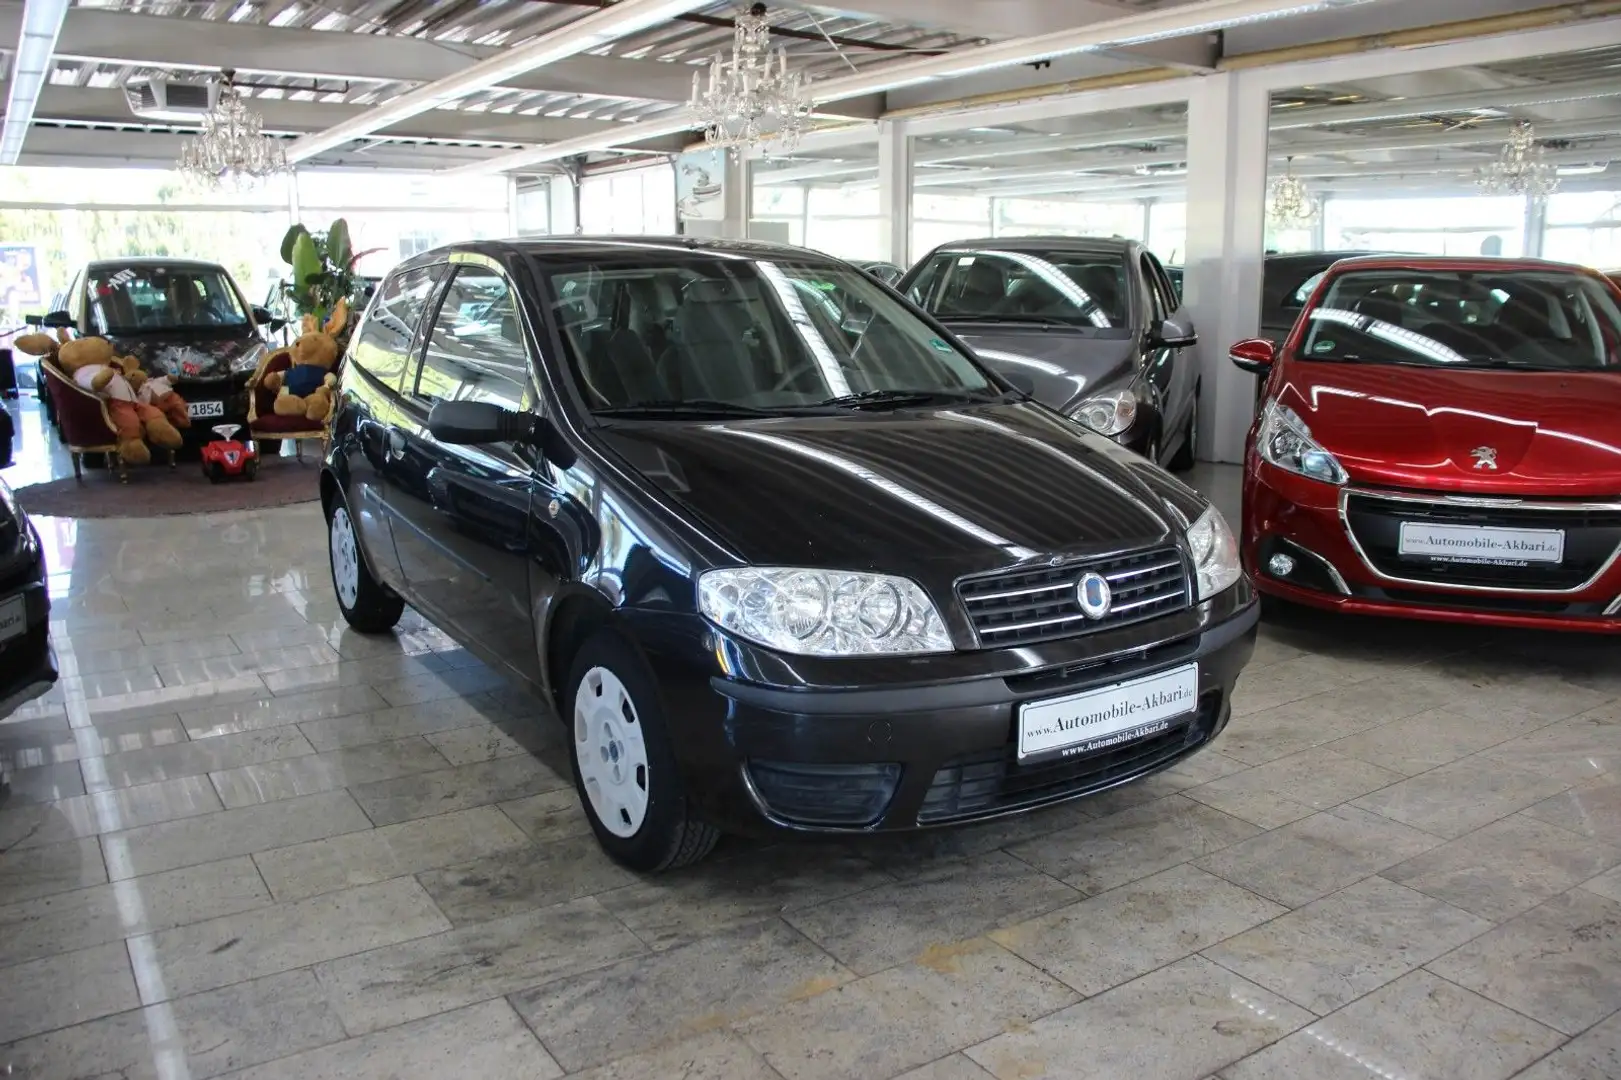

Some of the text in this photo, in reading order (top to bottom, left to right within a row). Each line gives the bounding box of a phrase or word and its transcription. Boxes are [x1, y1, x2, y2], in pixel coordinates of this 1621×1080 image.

[192, 403, 221, 416] 1854
[1027, 686, 1193, 738] www.Automobile-Akbari.de
[1062, 721, 1169, 756] www.Automobile-Akbari.de
